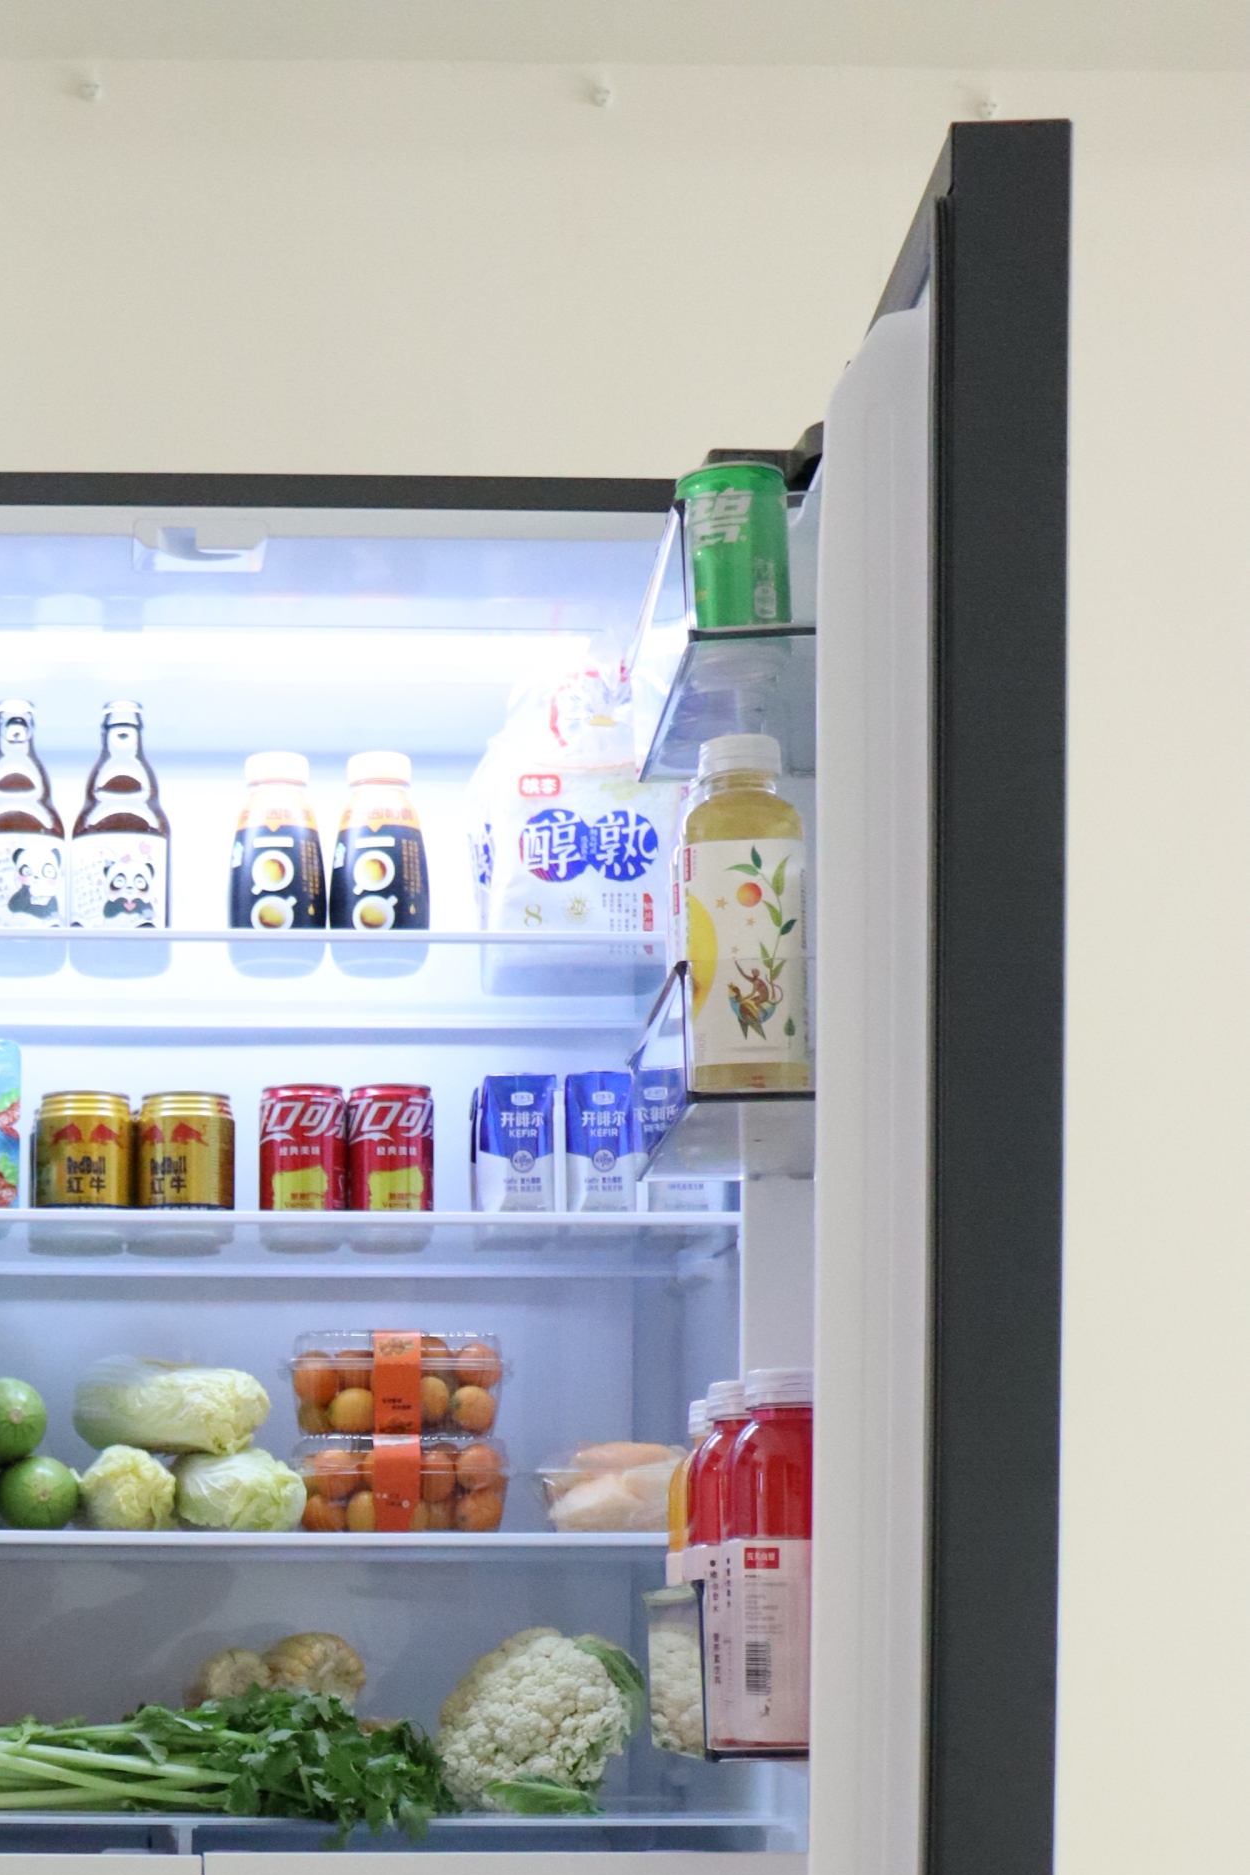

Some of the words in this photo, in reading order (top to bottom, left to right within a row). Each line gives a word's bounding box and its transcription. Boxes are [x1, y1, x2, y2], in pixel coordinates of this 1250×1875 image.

[523, 805, 659, 878] 醇熟
[500, 1110, 544, 1128] 开啡尔
[581, 1110, 627, 1128] 开啡尔
[509, 1128, 538, 1139] KEFIR
[590, 1128, 619, 1139] KEFIR
[66, 1177, 106, 1194] 红牛
[150, 1177, 187, 1195] 红牛
